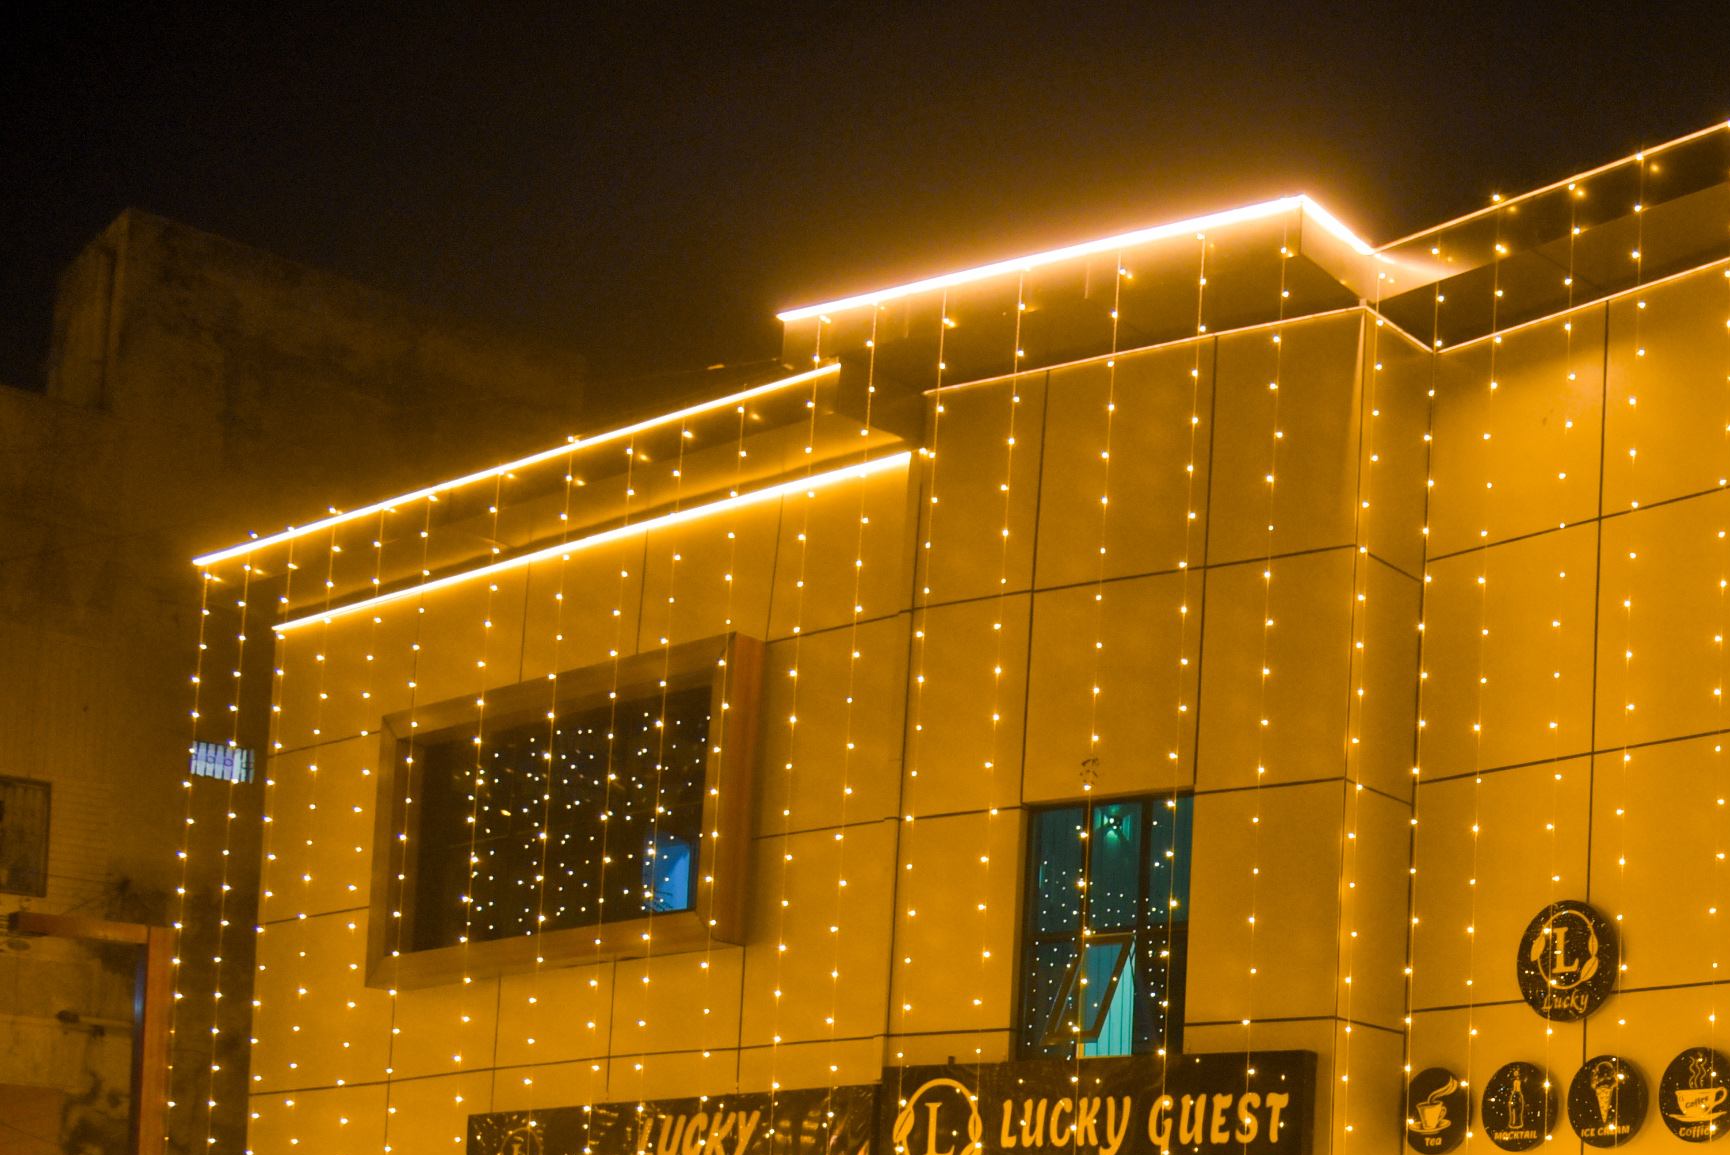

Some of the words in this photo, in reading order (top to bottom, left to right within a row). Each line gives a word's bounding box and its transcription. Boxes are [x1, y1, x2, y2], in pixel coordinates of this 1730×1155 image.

[1542, 989, 1589, 1011] Lucky
[1148, 1092, 1289, 1146] GUEST
[1494, 1130, 1537, 1140] MOCKTAIL
[1581, 1128, 1595, 1137] ICE
[1425, 1137, 1442, 1147] Tea
